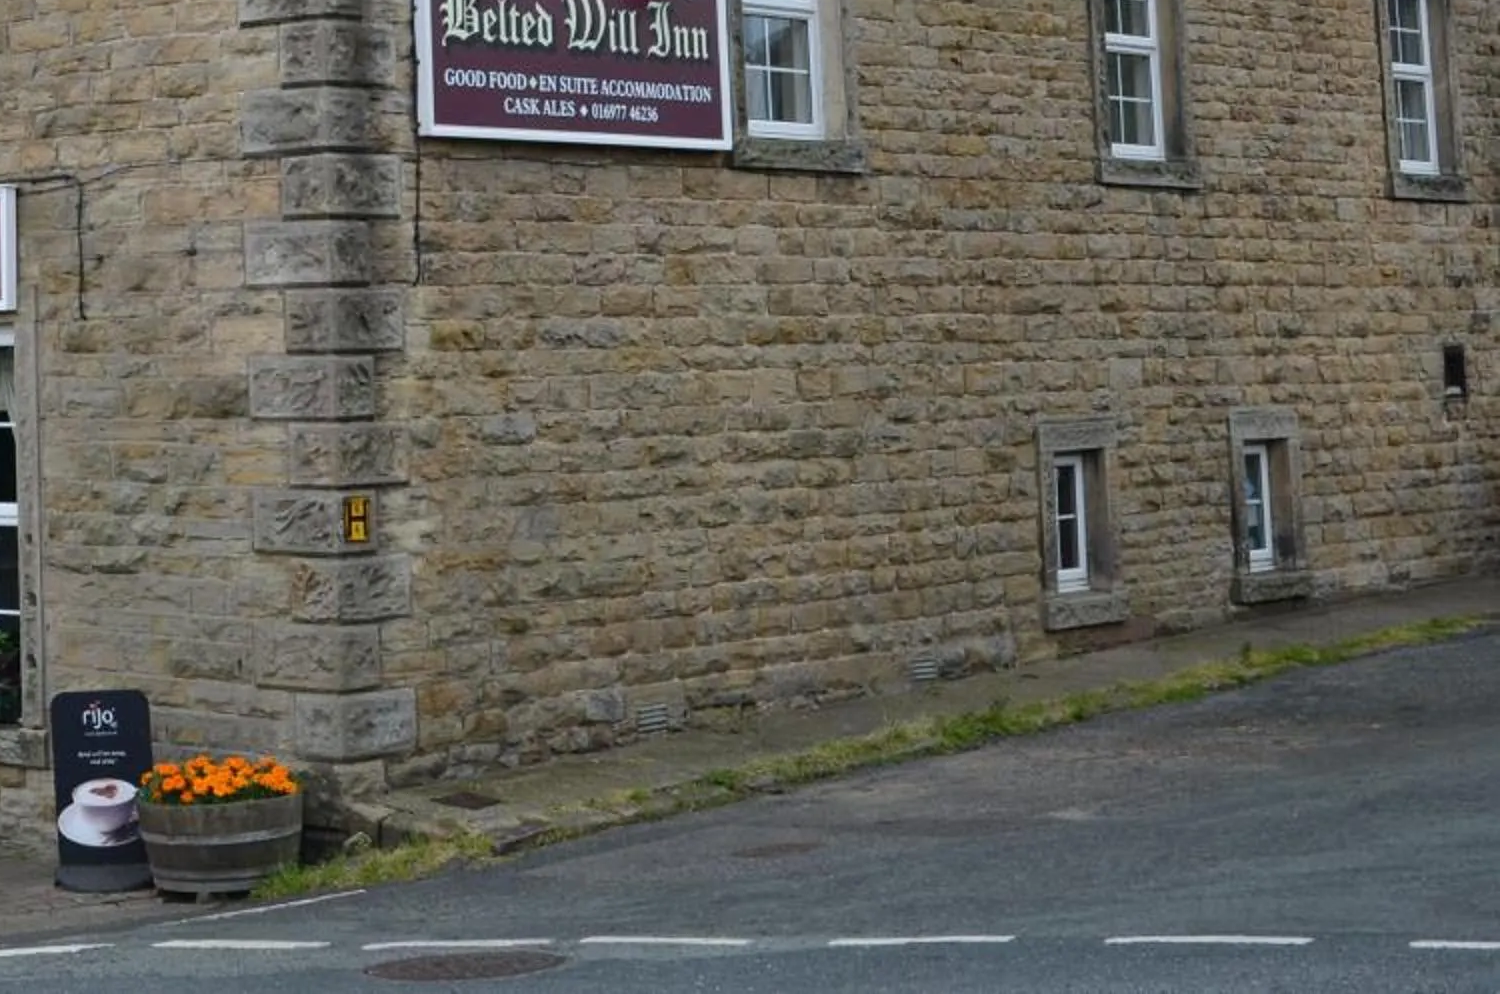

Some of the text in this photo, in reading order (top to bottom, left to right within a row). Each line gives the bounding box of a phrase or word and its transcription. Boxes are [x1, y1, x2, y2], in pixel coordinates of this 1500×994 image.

[647, 1, 710, 59] Inn
[444, 67, 712, 103] GOOD FOOD EN SUITE ACCOMMODATION
[504, 97, 659, 123] CASK ALES 016977 46236
